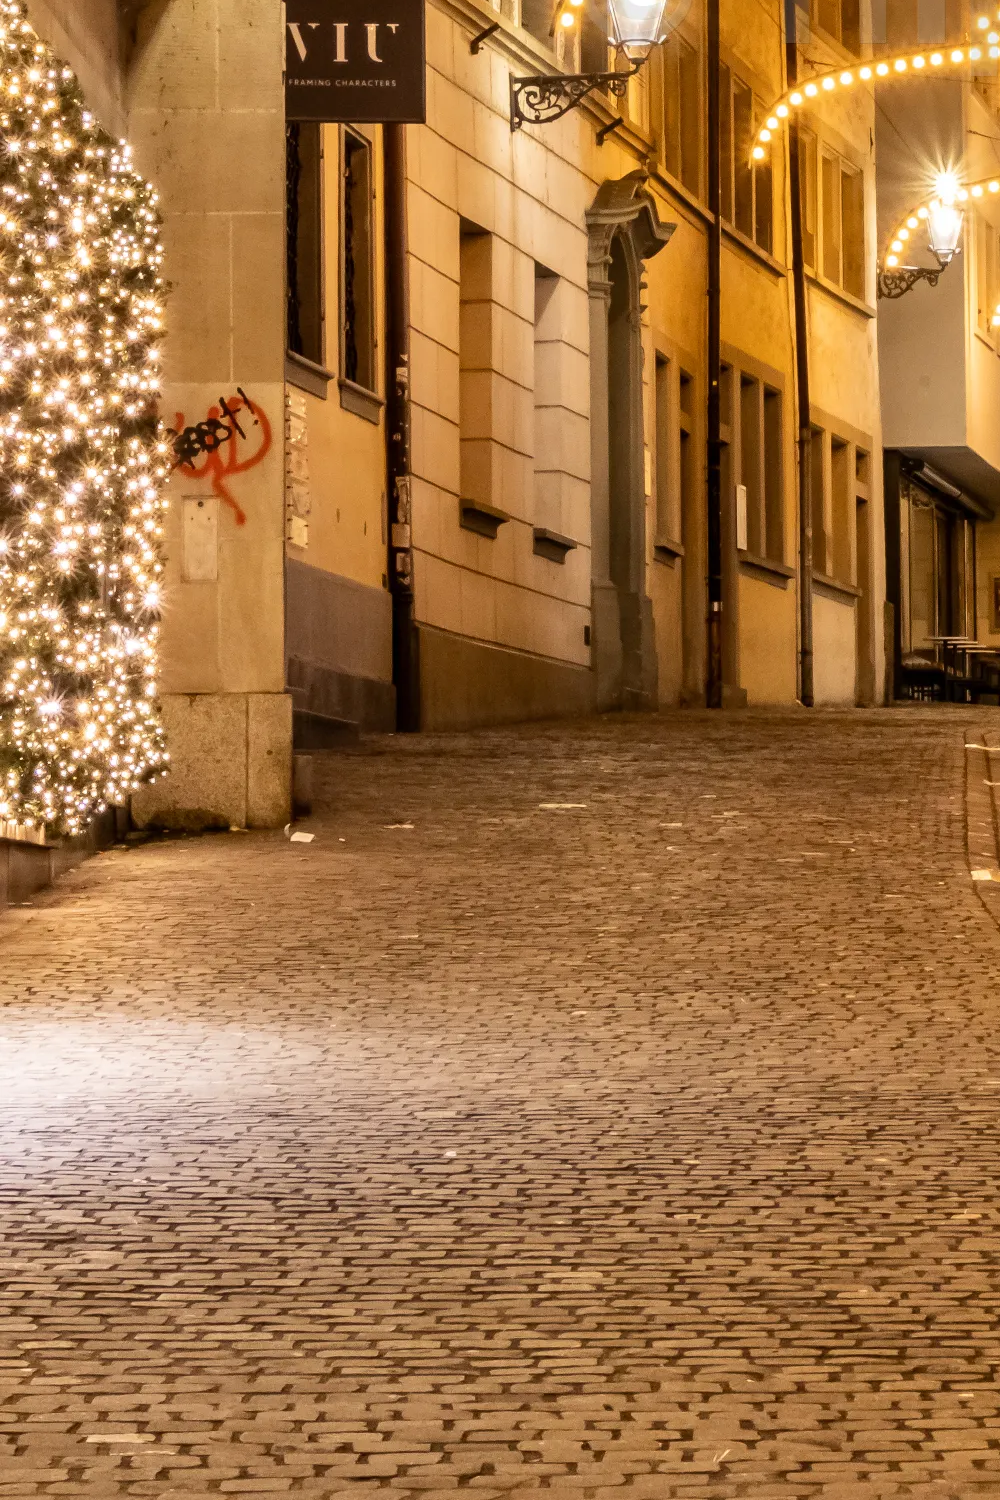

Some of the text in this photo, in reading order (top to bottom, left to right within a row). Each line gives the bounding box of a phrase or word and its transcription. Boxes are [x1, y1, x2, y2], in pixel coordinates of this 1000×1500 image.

[286, 22, 400, 63] VIU
[288, 78, 397, 87] FRAMING CHARACTERS
